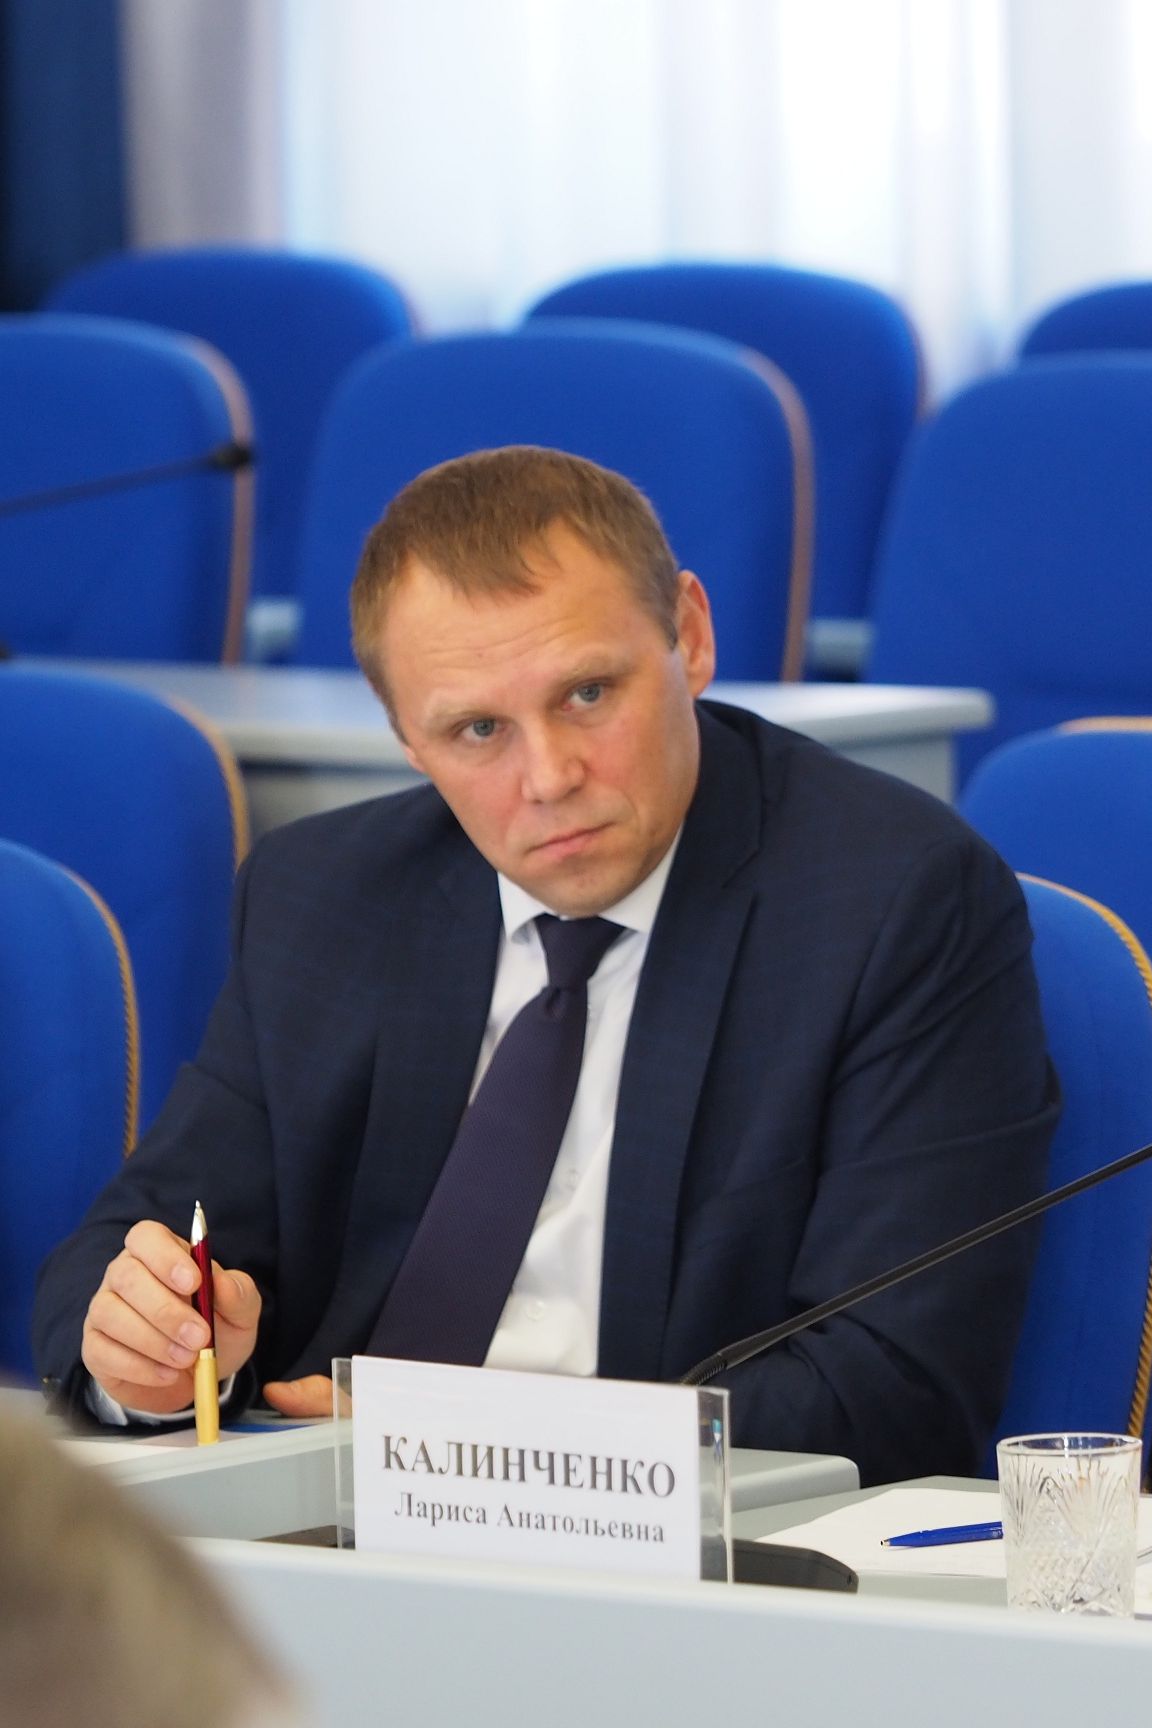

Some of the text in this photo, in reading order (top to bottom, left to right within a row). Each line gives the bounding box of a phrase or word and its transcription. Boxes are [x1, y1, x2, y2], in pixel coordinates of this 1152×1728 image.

[382, 1434, 675, 1498] КАЛИНЧЕНКО
[394, 1491, 665, 1543] Лариса Анатольевна
